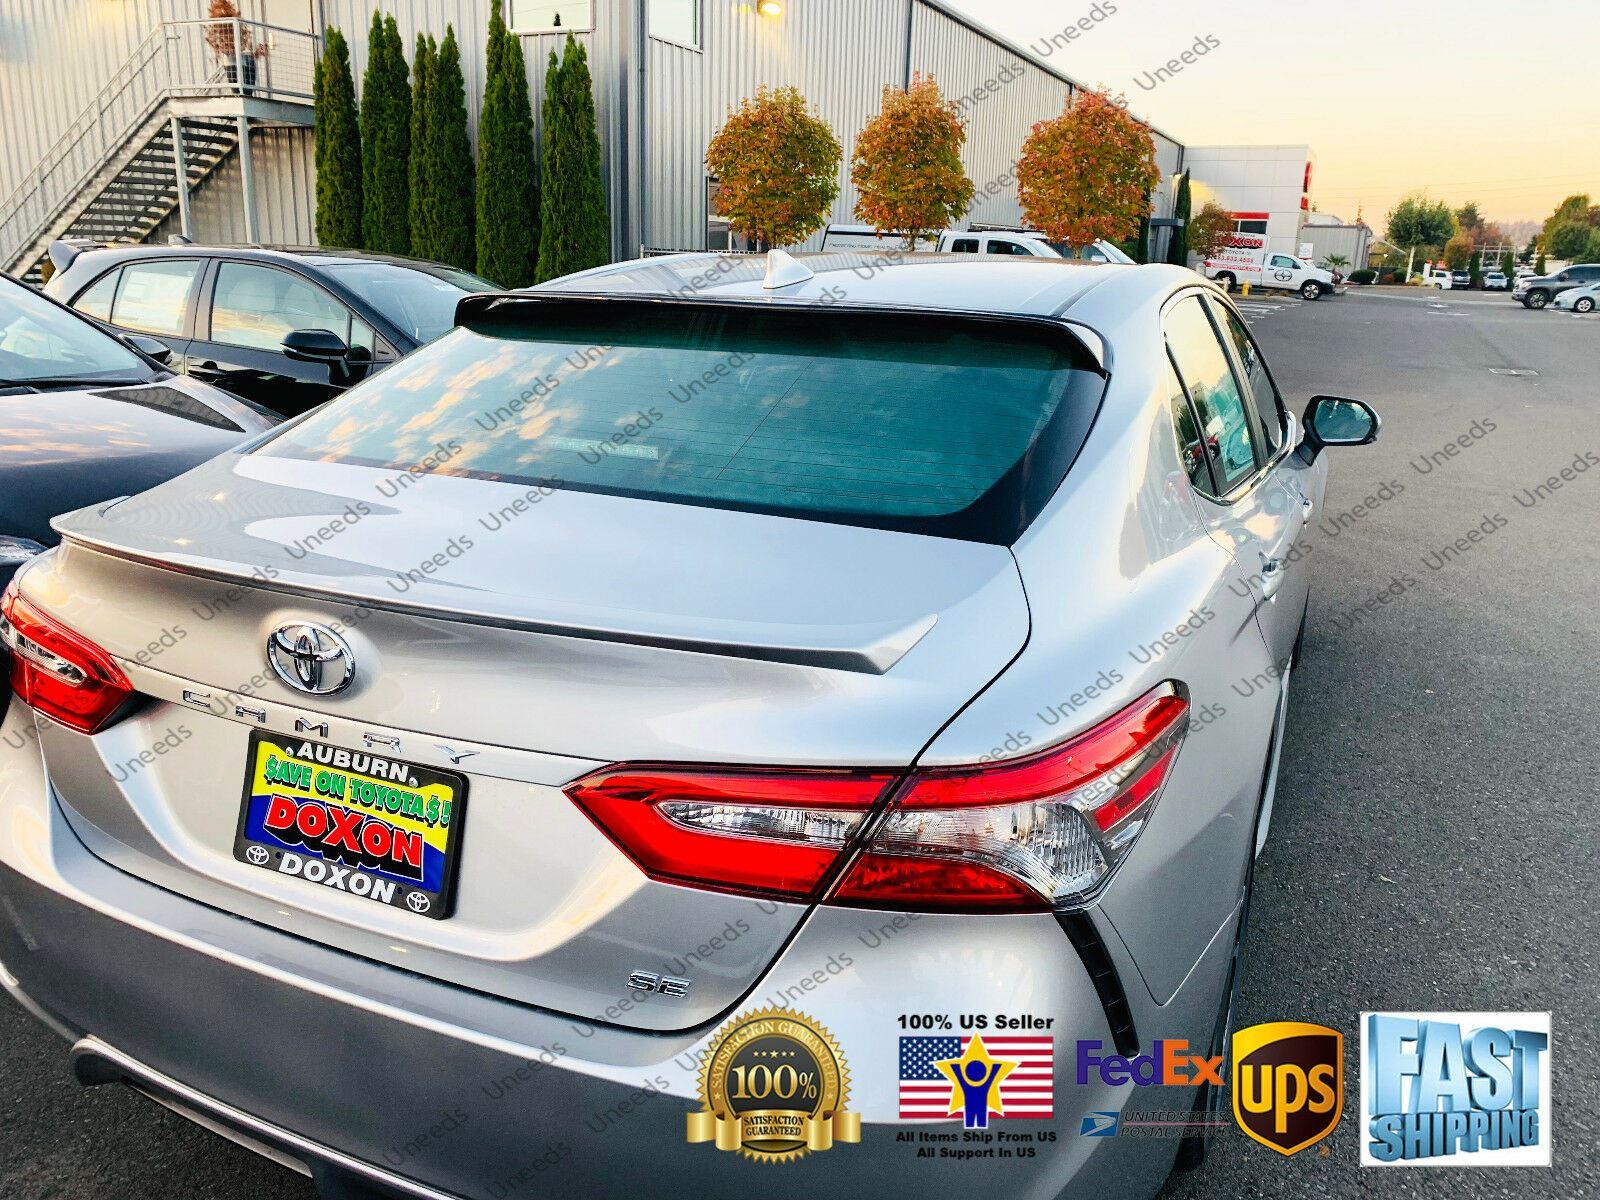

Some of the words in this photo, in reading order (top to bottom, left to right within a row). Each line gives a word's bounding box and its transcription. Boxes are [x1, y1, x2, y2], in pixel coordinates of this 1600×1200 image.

[183, 689, 480, 765] CAMRY
[296, 742, 409, 782] AUBURN
[314, 769, 347, 800] ON
[263, 794, 424, 875] DOXON
[277, 852, 398, 904] DOXON
[626, 969, 692, 999] SE
